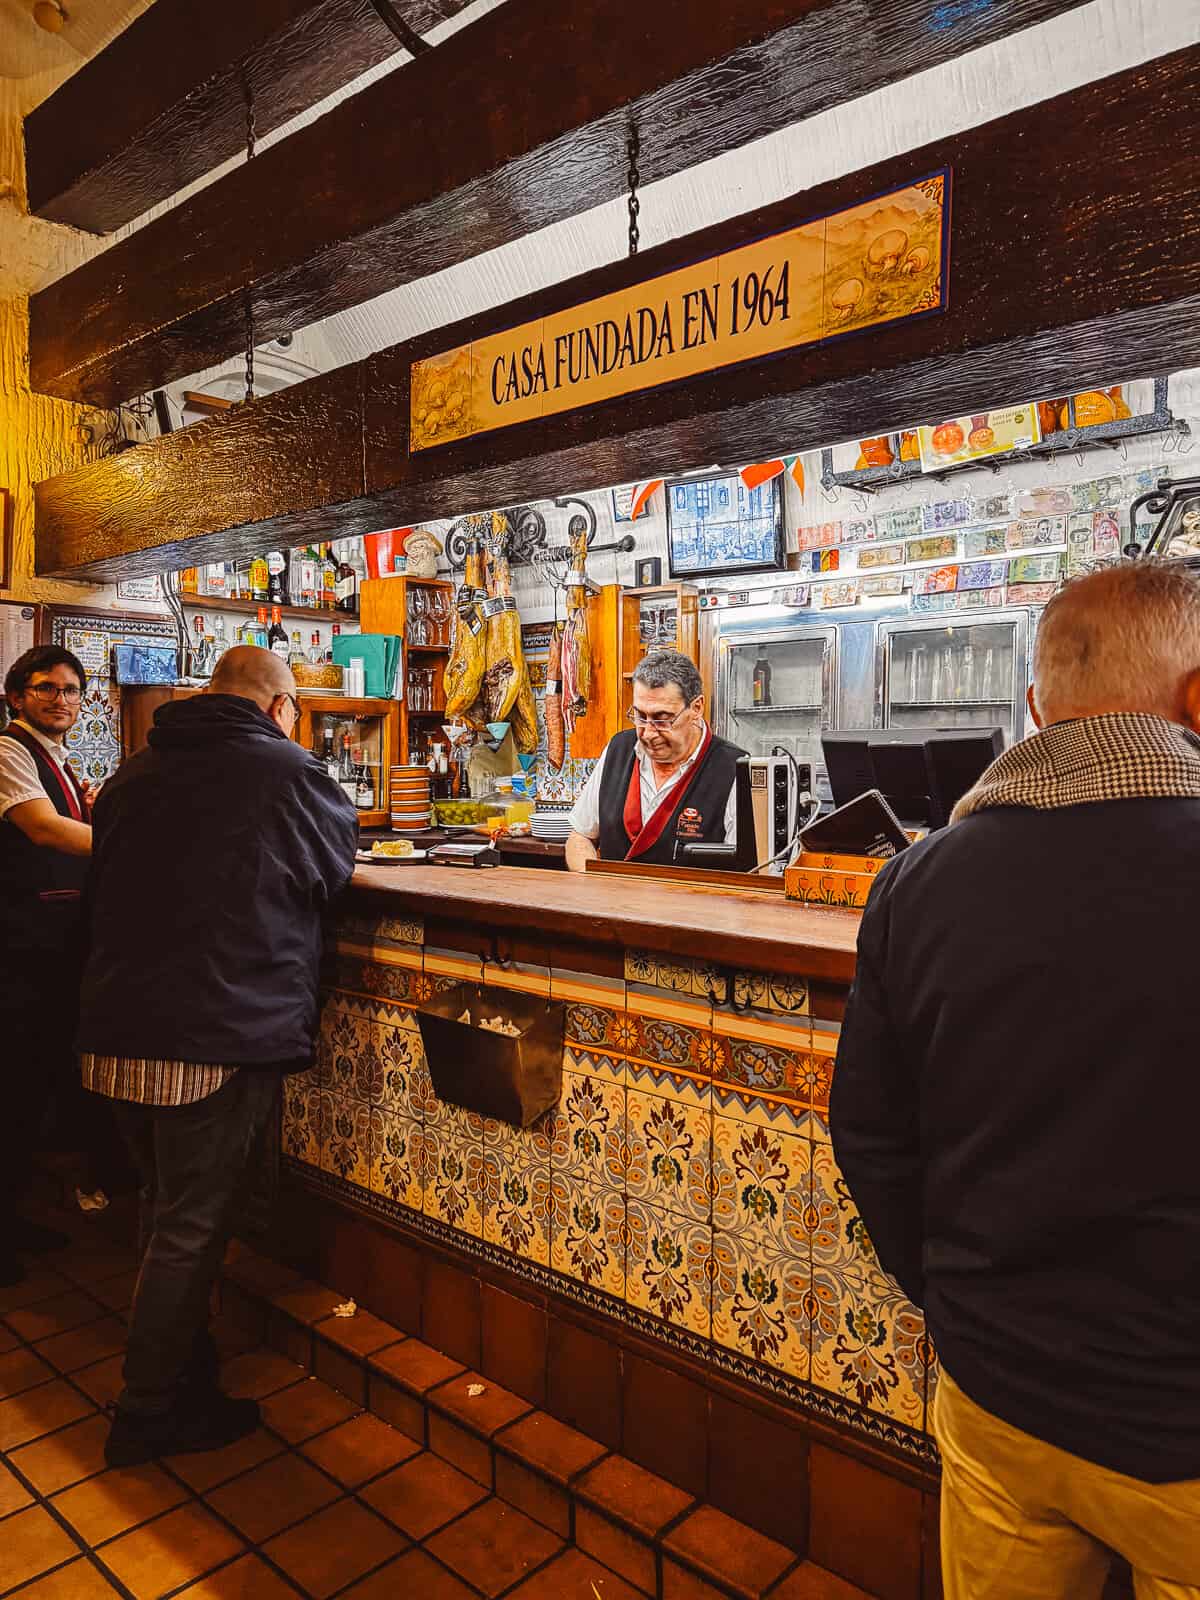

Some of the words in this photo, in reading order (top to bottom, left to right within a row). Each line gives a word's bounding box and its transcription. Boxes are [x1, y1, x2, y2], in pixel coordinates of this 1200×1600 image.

[491, 343, 549, 406] CASA
[553, 302, 675, 389] FUNDADA
[681, 284, 720, 351] EN
[729, 260, 791, 336] 1964
